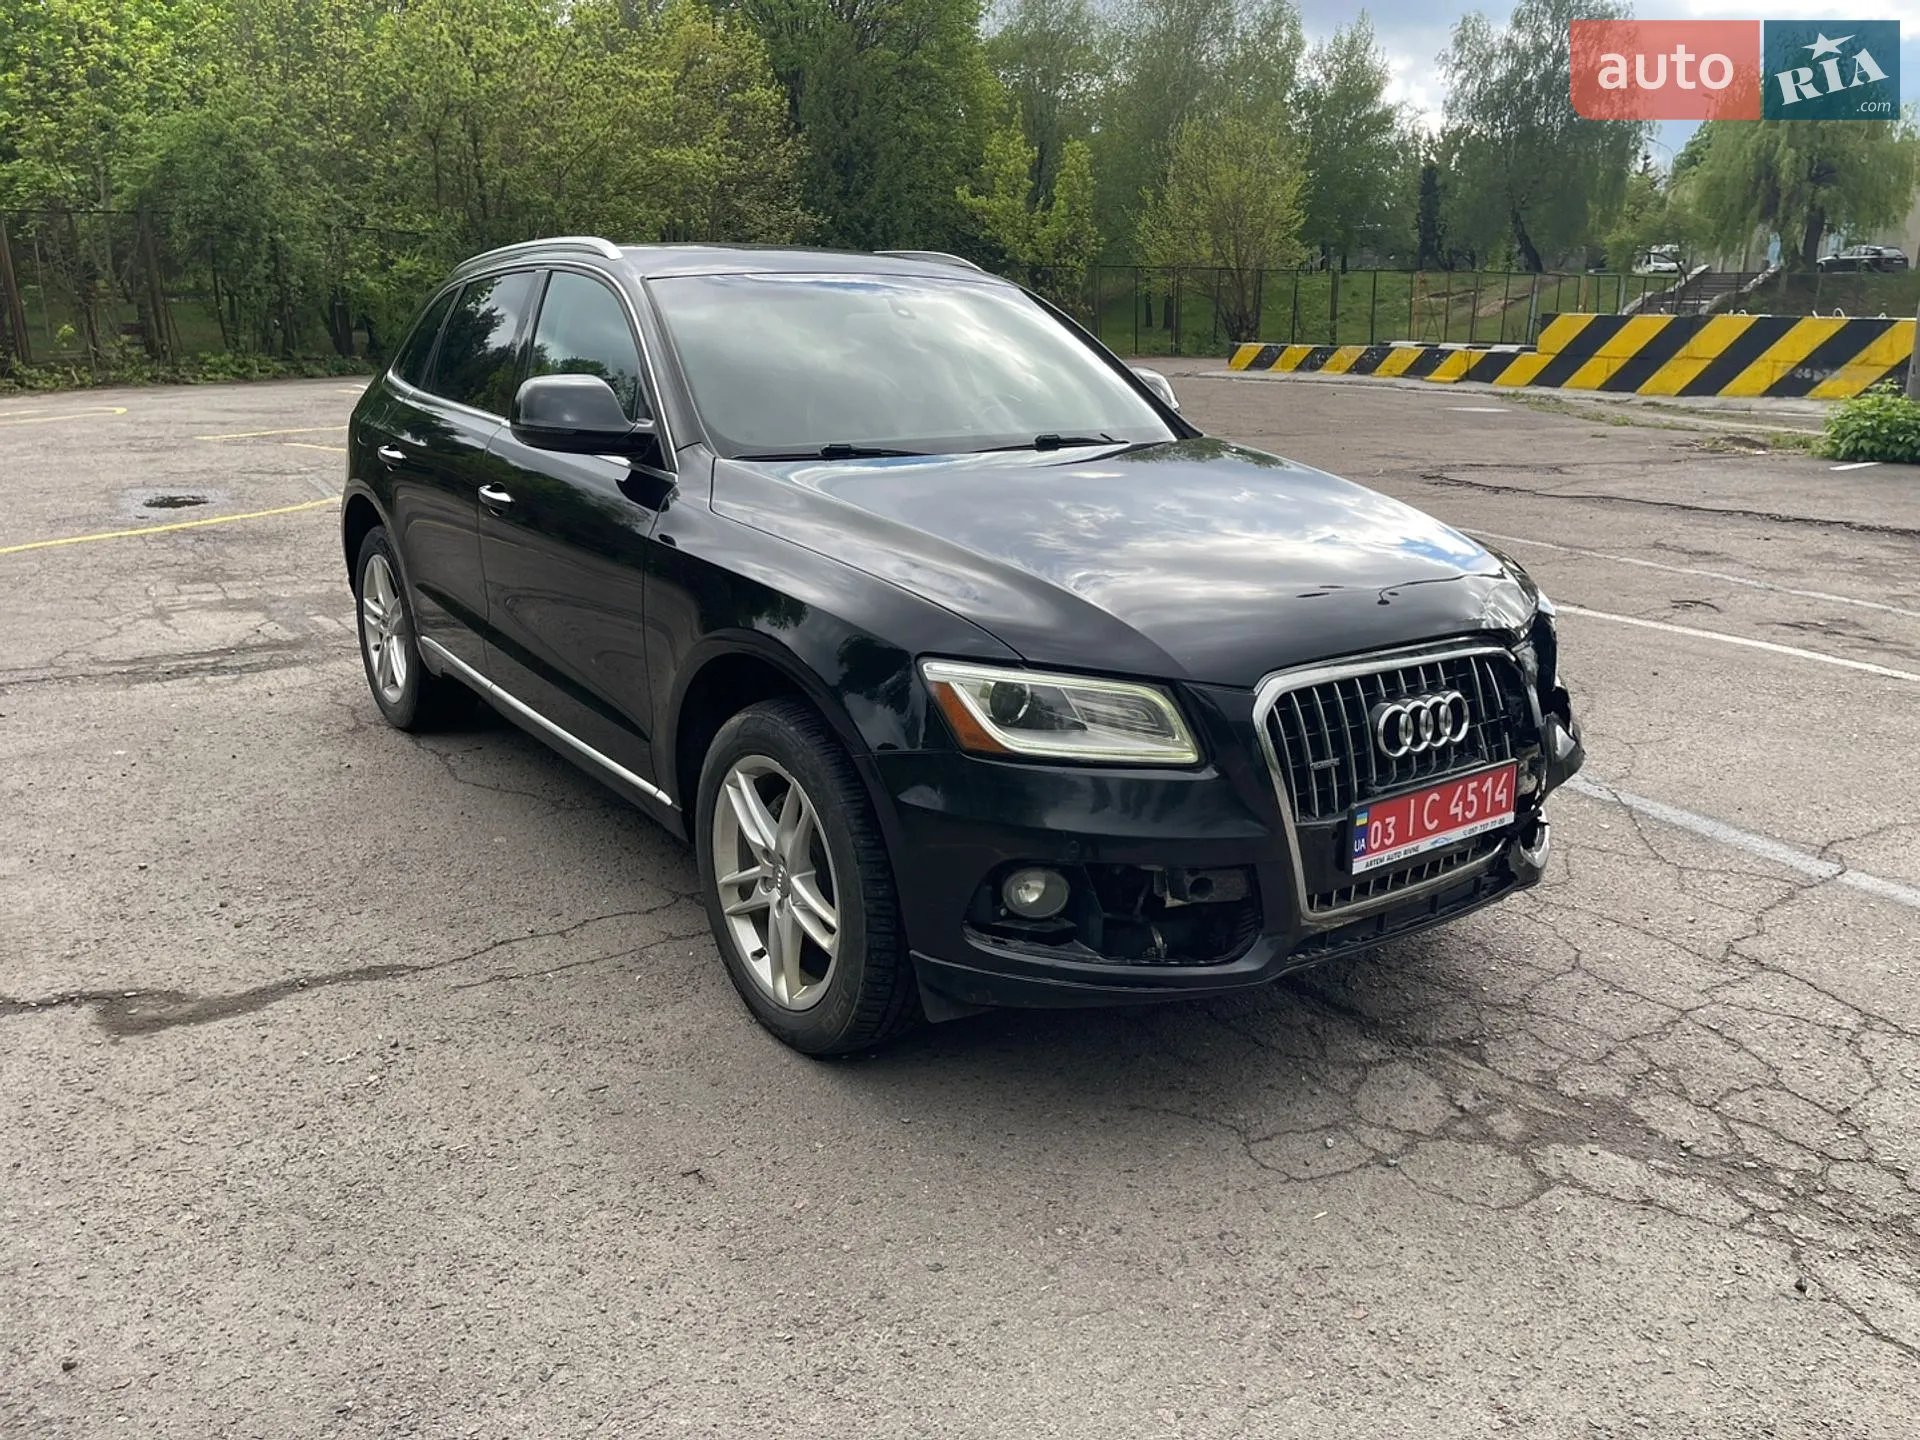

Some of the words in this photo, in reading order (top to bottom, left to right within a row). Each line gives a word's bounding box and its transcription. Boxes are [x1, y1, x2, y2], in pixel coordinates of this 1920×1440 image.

[1370, 816, 1396, 850] 03
[1408, 793, 1440, 836] IC
[1450, 772, 1508, 822] 4514
[1354, 838, 1366, 852] UA
[1386, 850, 1402, 861] AUTO
